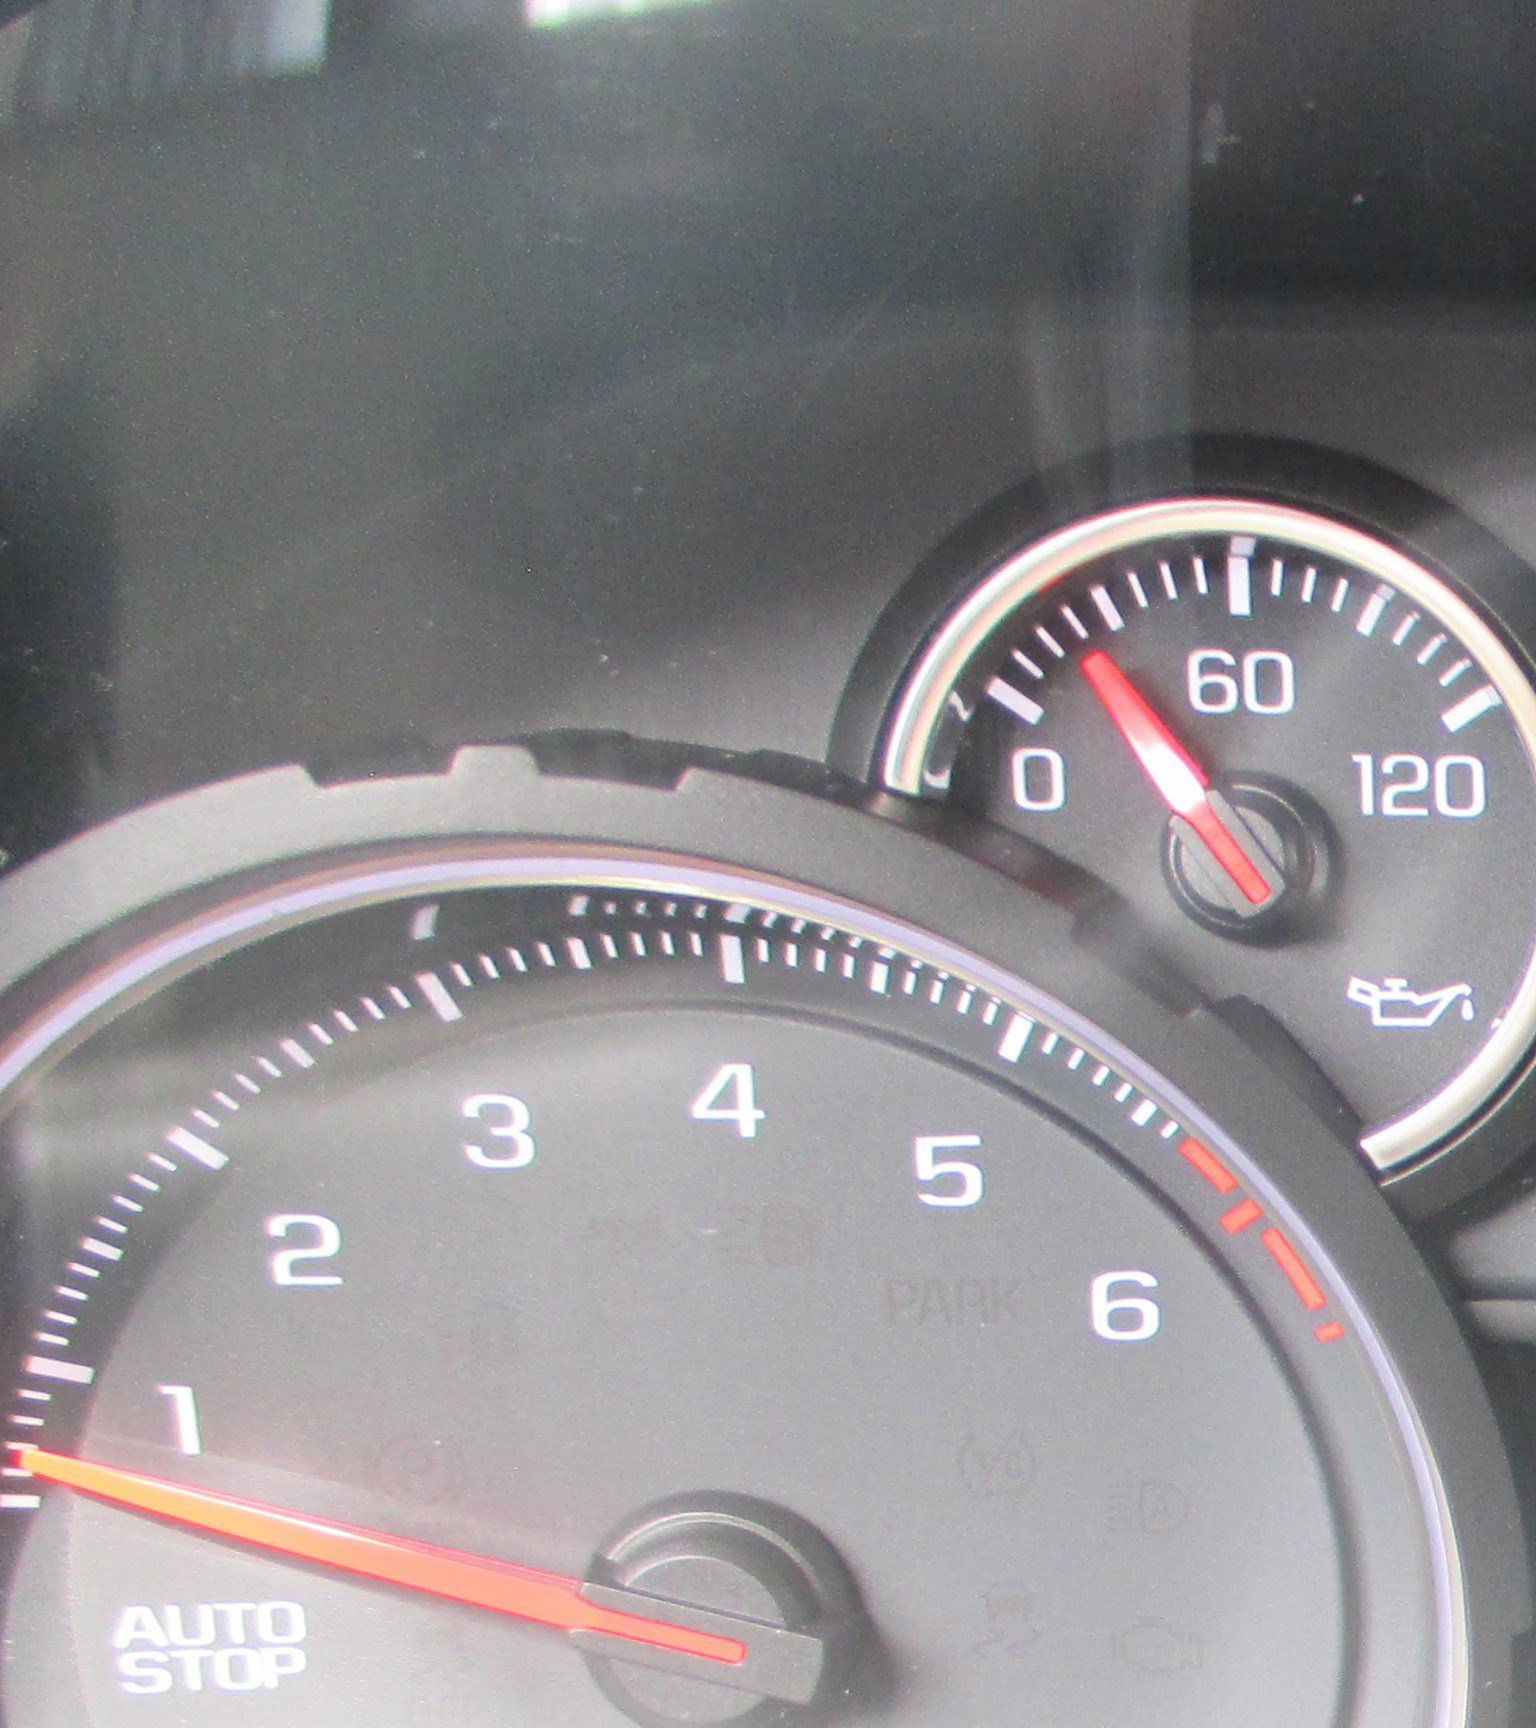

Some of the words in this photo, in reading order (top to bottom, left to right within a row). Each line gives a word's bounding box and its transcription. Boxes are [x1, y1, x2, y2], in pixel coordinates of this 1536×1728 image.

[1187, 649, 1294, 715] 60
[1012, 747, 1064, 811] 0
[1352, 754, 1485, 819] 120
[460, 1093, 534, 1169] 3
[690, 1063, 764, 1138] 4
[914, 1134, 982, 1208] 5
[265, 1214, 342, 1287] 2
[1091, 1271, 1159, 1343] 6
[157, 1385, 200, 1457] 1
[112, 1601, 305, 1649] AUTO
[118, 1647, 306, 1696] STOP
